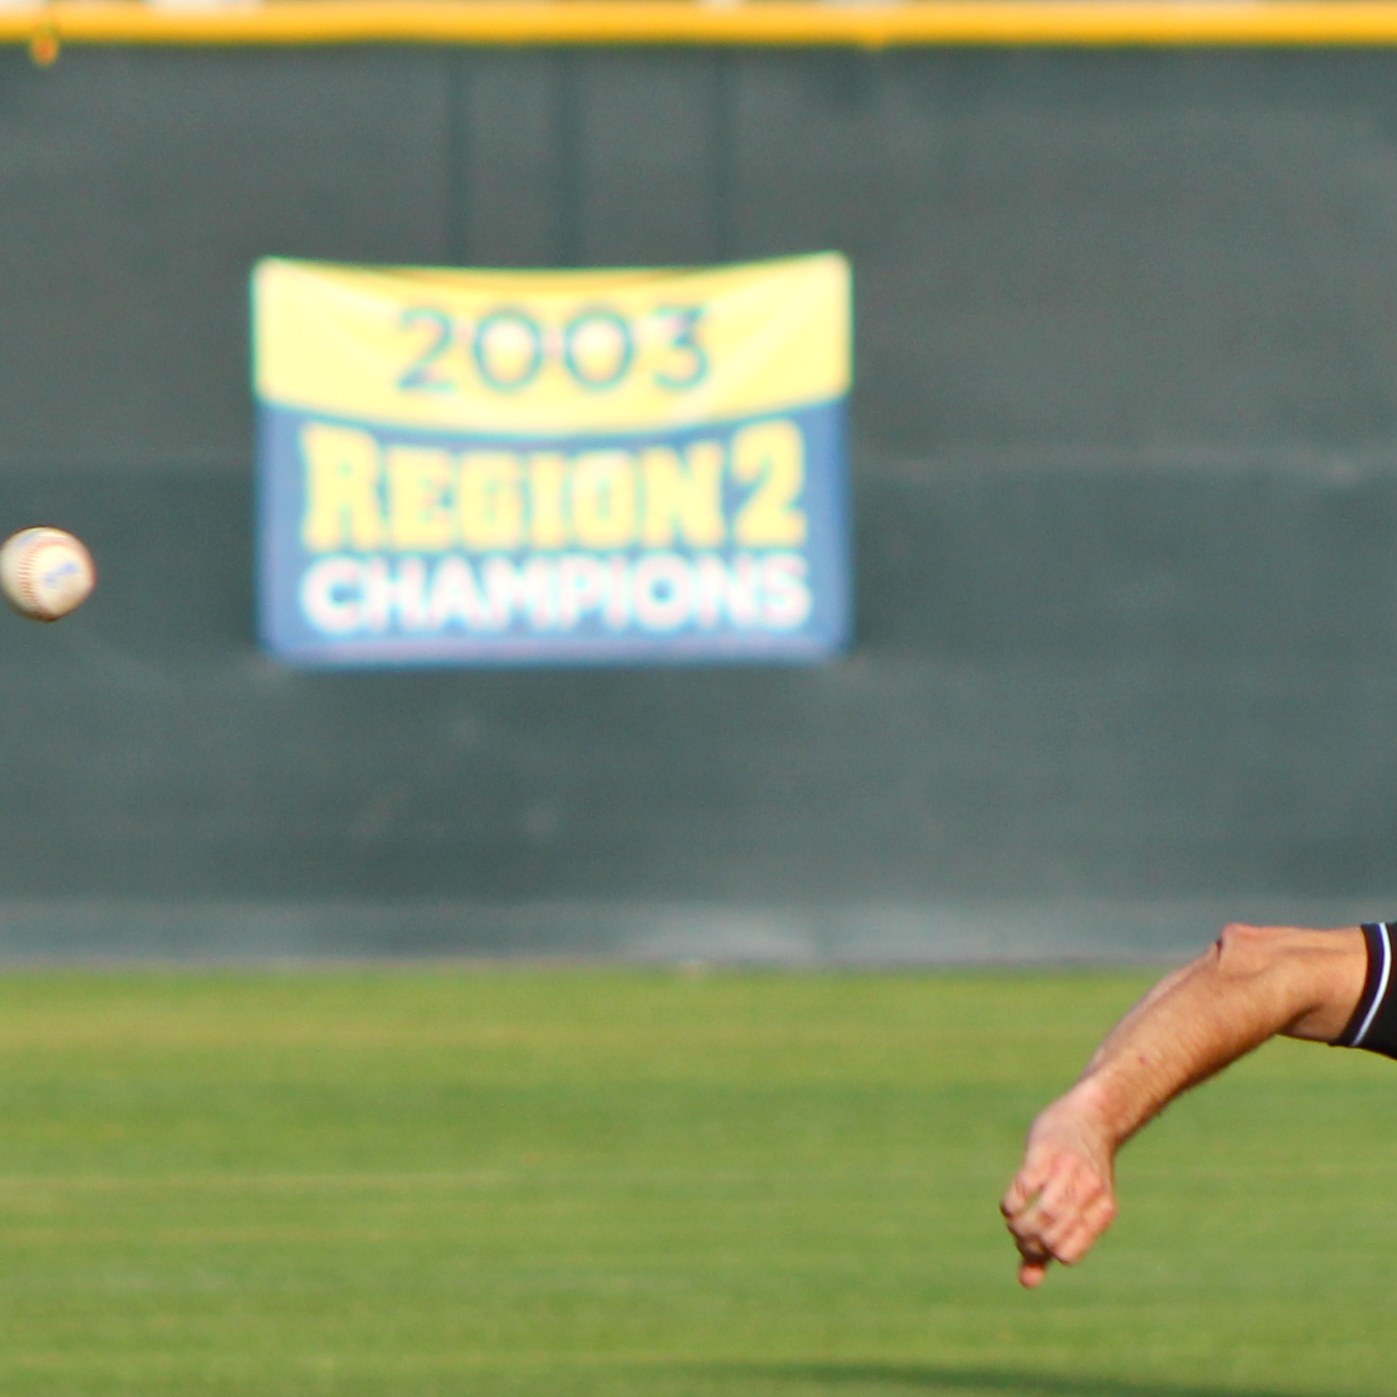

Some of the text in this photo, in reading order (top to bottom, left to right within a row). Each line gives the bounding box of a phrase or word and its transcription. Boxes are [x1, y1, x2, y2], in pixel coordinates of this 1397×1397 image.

[394, 306, 713, 392] 2003
[301, 416, 806, 552] REGION 2
[300, 551, 811, 632] CHAMPIONS
